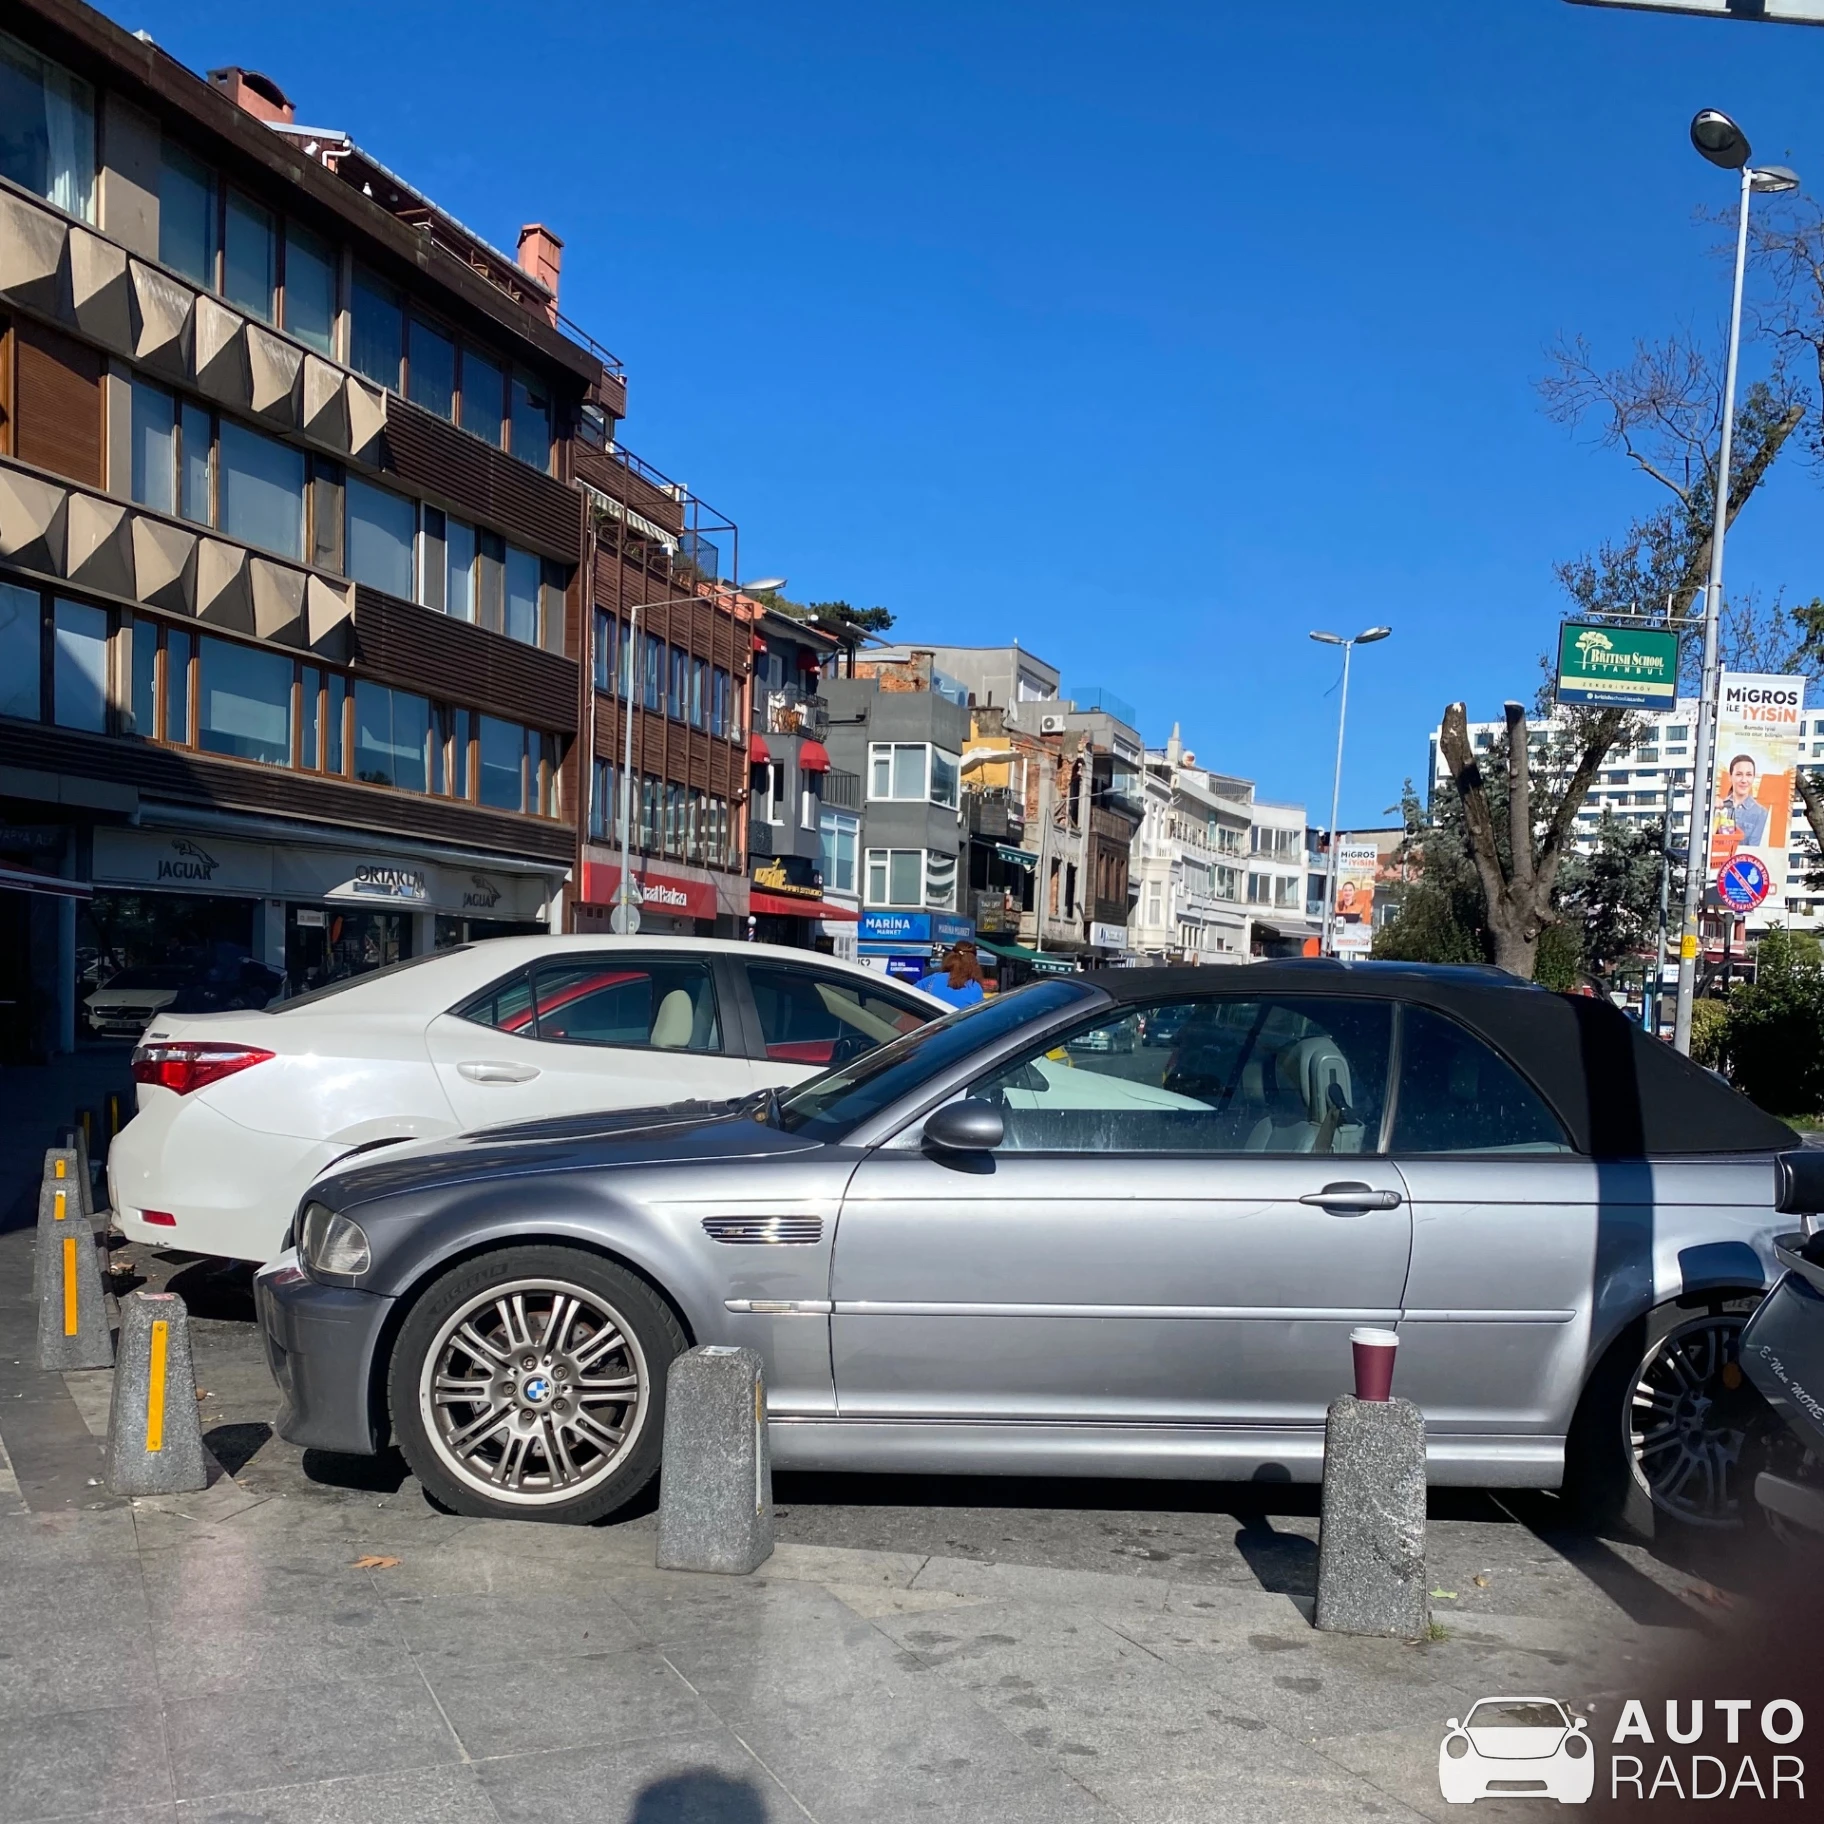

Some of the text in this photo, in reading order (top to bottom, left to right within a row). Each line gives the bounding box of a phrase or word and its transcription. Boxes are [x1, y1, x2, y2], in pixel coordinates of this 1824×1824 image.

[1632, 651, 1665, 668] SCHOOL
[157, 860, 212, 880] JAGUAR
[1791, 1382, 1824, 1426] MONE
